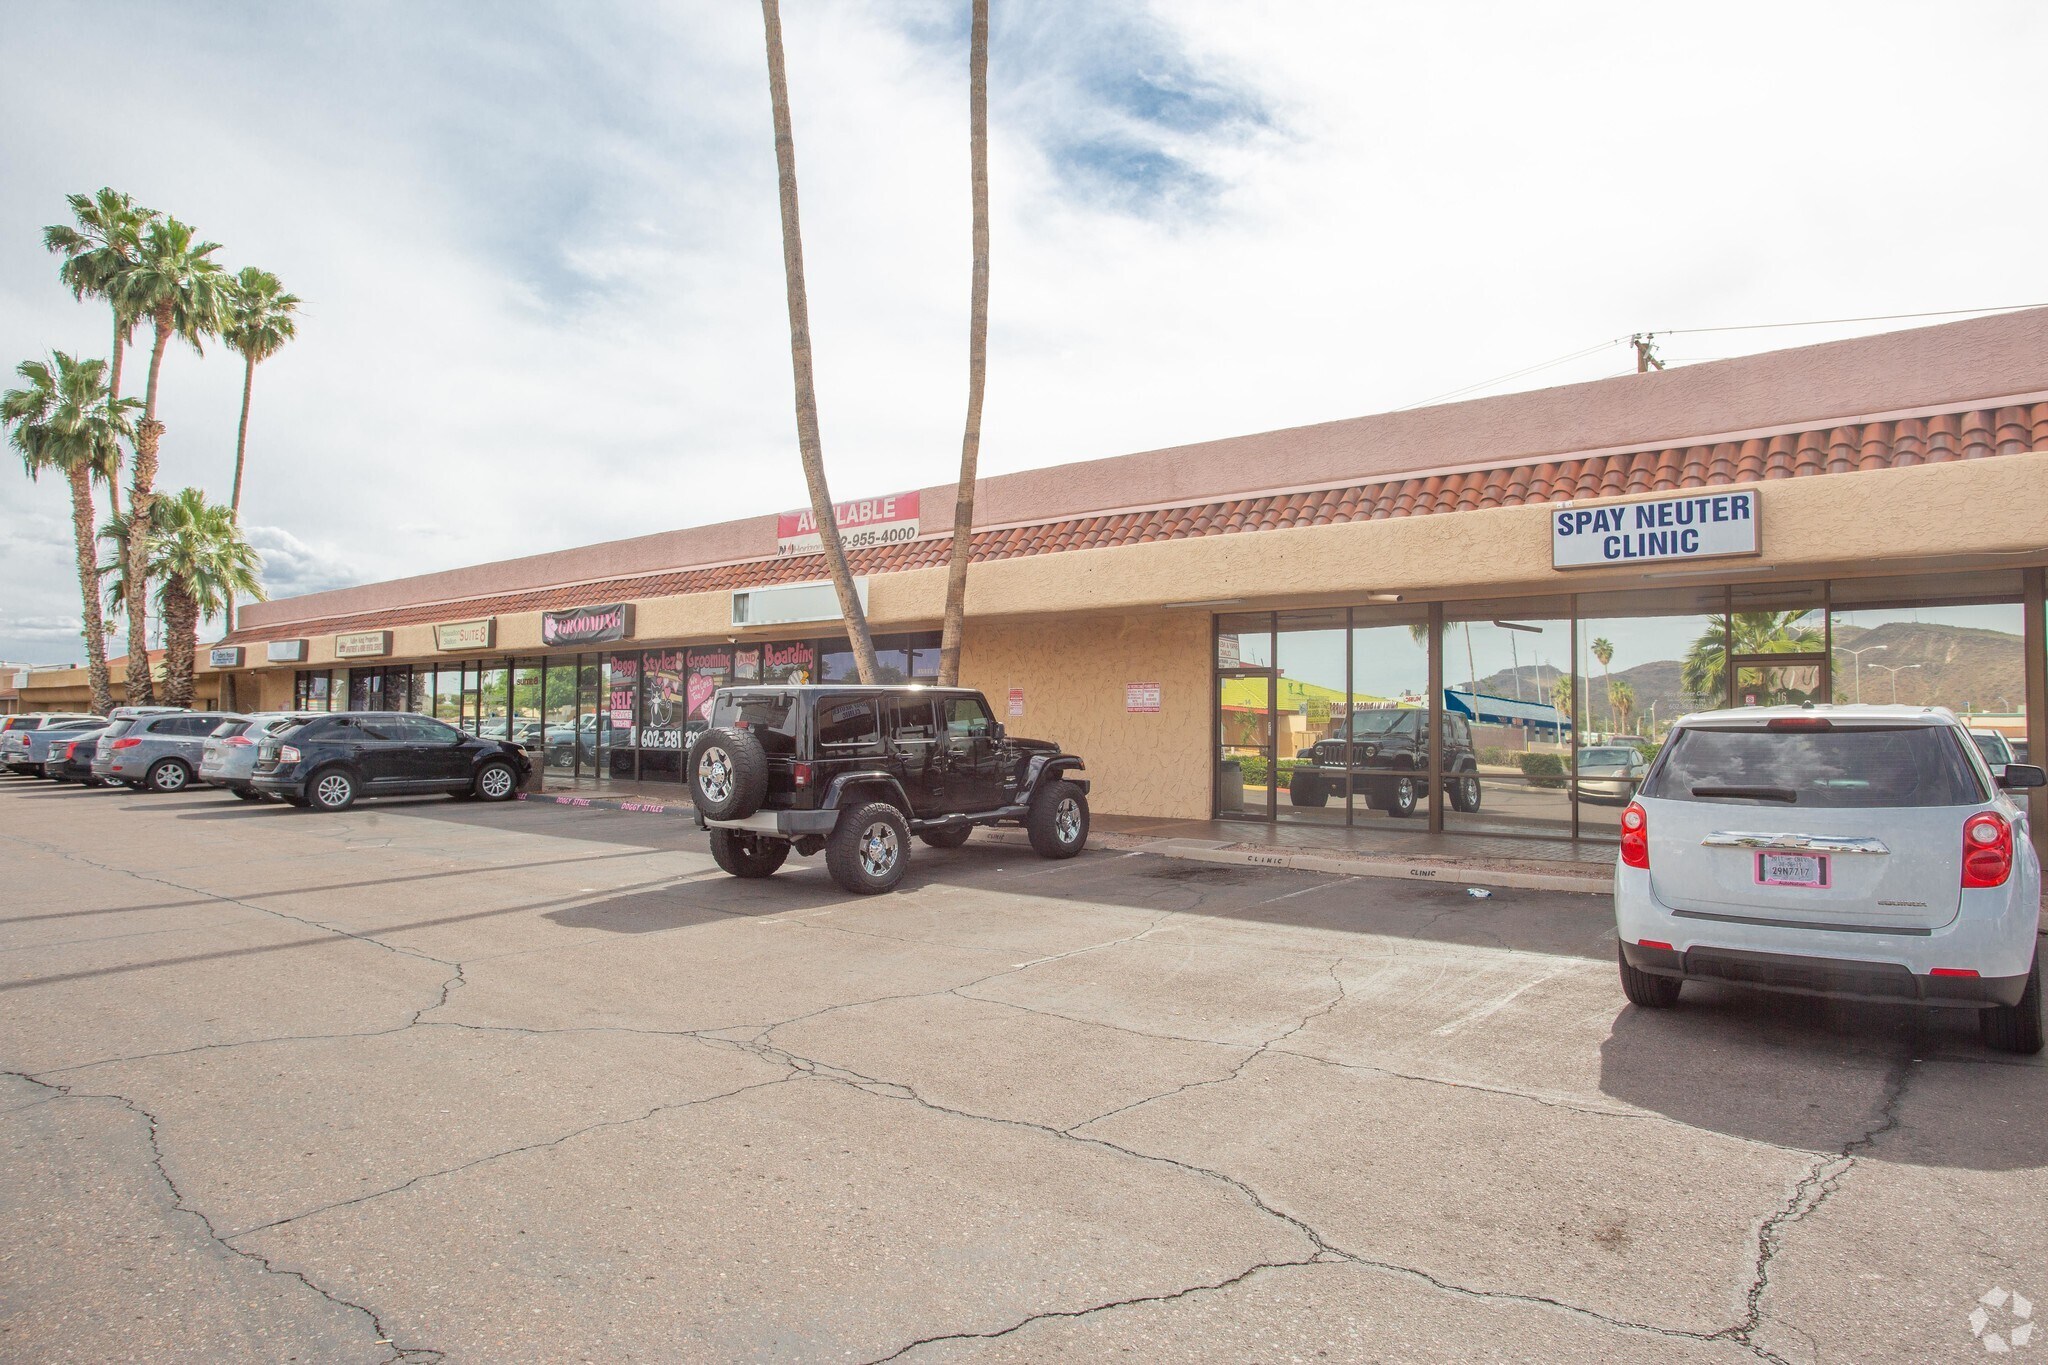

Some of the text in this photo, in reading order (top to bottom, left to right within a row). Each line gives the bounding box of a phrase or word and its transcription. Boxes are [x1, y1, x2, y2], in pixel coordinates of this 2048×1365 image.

[797, 497, 896, 532] AVLABLE
[1558, 495, 1750, 536] SPAY NEUTER
[841, 527, 916, 548] 2-955-4000
[1603, 528, 1699, 559] CLINIC
[558, 611, 621, 634] GROOMING
[460, 626, 486, 643] SUITE 8
[611, 648, 731, 678] Doggy Stylez Grooming
[740, 654, 756, 663] AND
[765, 642, 814, 669] Boarding
[611, 691, 632, 709] SELF
[1777, 692, 1787, 702] 16
[556, 796, 572, 804] DOGGY
[620, 803, 664, 813] DOGGY STYLEZ
[1247, 855, 1282, 864] CLINIC
[1410, 869, 1436, 877] CLINIC
[1772, 866, 1809, 876] 29N7717
